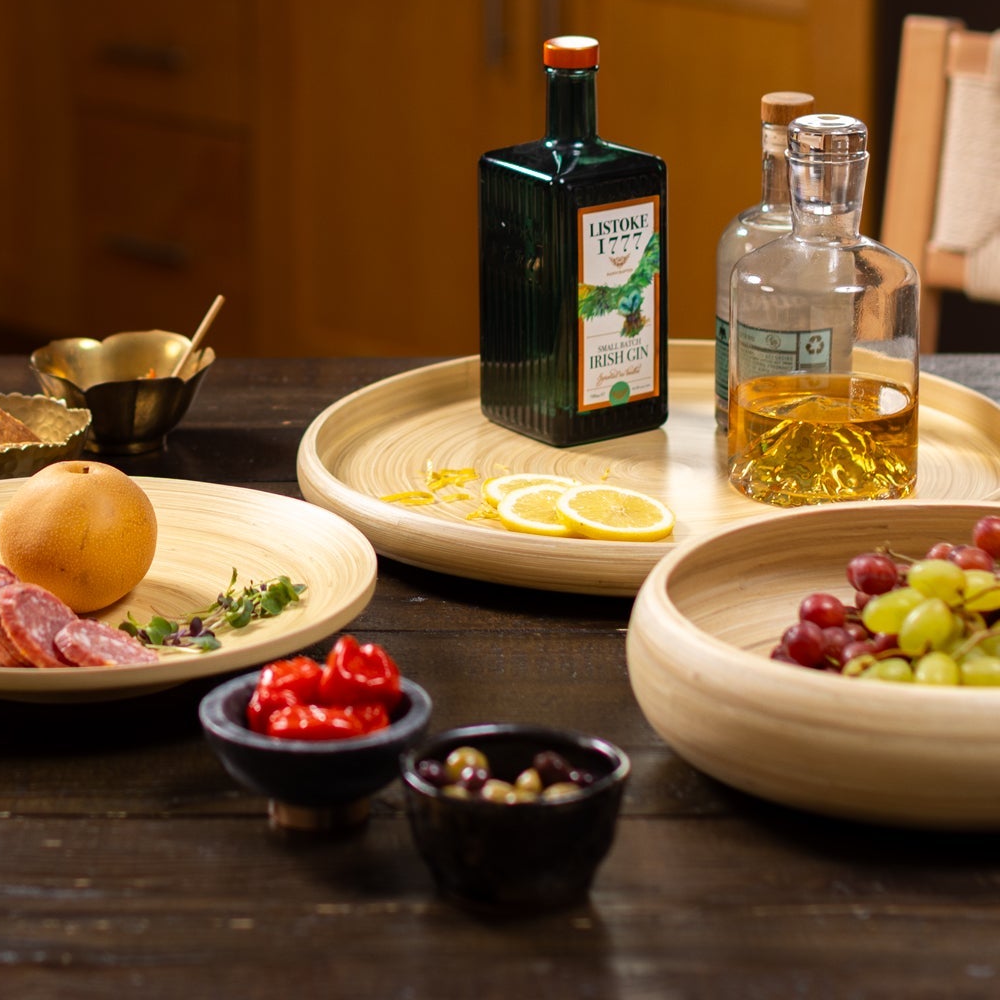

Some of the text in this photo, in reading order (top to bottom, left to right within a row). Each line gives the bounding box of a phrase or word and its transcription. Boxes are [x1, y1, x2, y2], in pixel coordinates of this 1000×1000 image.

[590, 214, 648, 237] LISTOKE
[598, 232, 642, 254] 1777
[598, 338, 641, 352] SMALL BATCH
[590, 344, 648, 369] IRISH GIN
